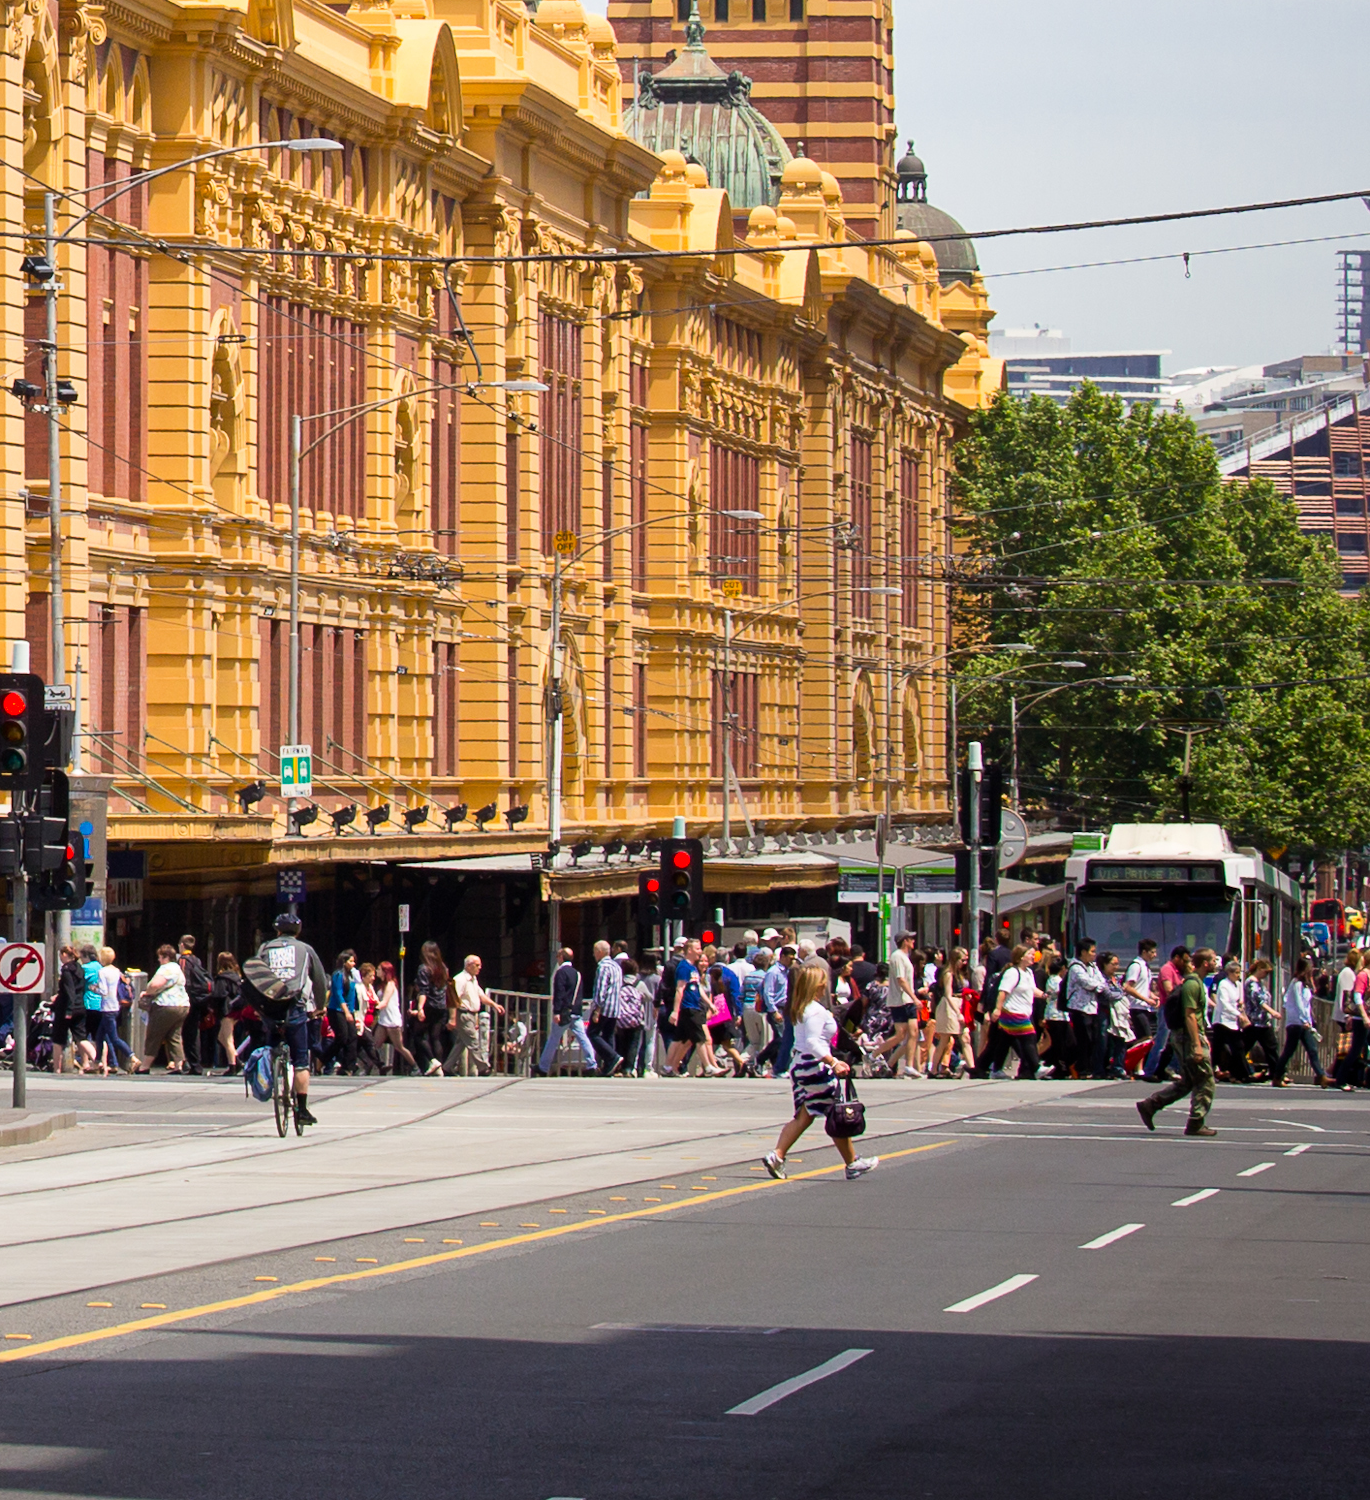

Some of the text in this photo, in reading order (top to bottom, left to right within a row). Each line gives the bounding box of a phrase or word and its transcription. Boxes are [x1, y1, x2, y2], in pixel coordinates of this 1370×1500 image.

[555, 533, 573, 542] CUT
[557, 542, 574, 551] OFF
[723, 581, 740, 589] CUT
